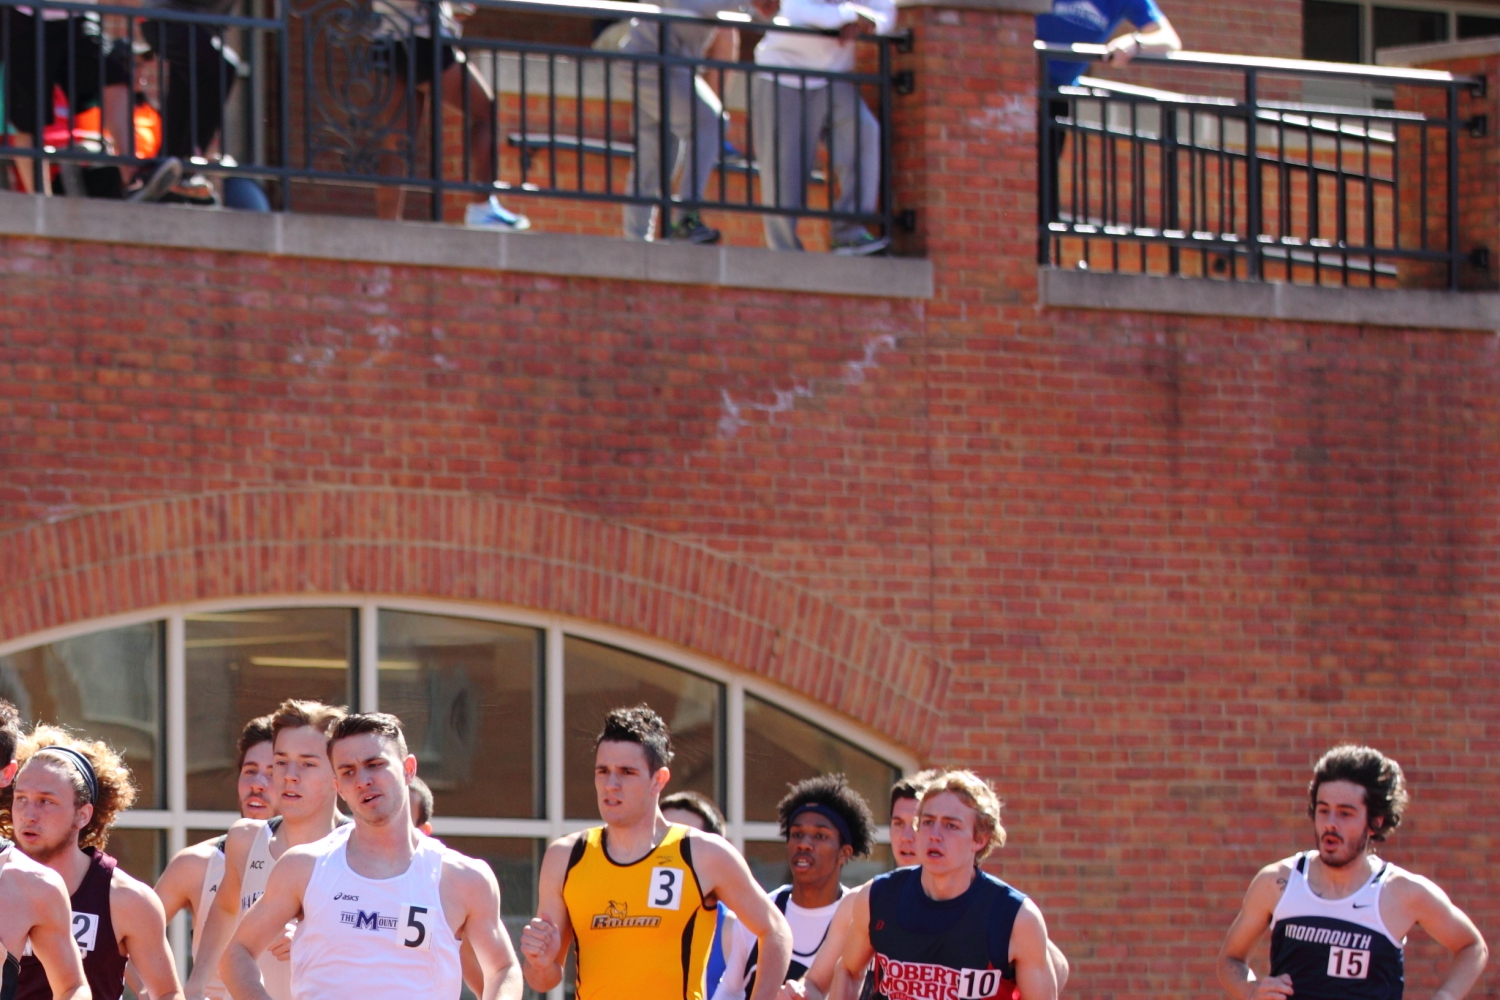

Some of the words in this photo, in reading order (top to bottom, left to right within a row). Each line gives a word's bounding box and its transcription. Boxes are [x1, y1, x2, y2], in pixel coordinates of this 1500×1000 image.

[250, 861, 265, 870] ACC
[342, 894, 360, 902] asics
[654, 870, 676, 906] 3
[72, 914, 91, 949] 2
[341, 913, 356, 923] THE
[404, 905, 428, 948] 5
[1285, 924, 1372, 950] MONMOUTH
[877, 951, 961, 987] ROBERT
[1332, 949, 1363, 977] 15
[964, 970, 996, 998] 10
